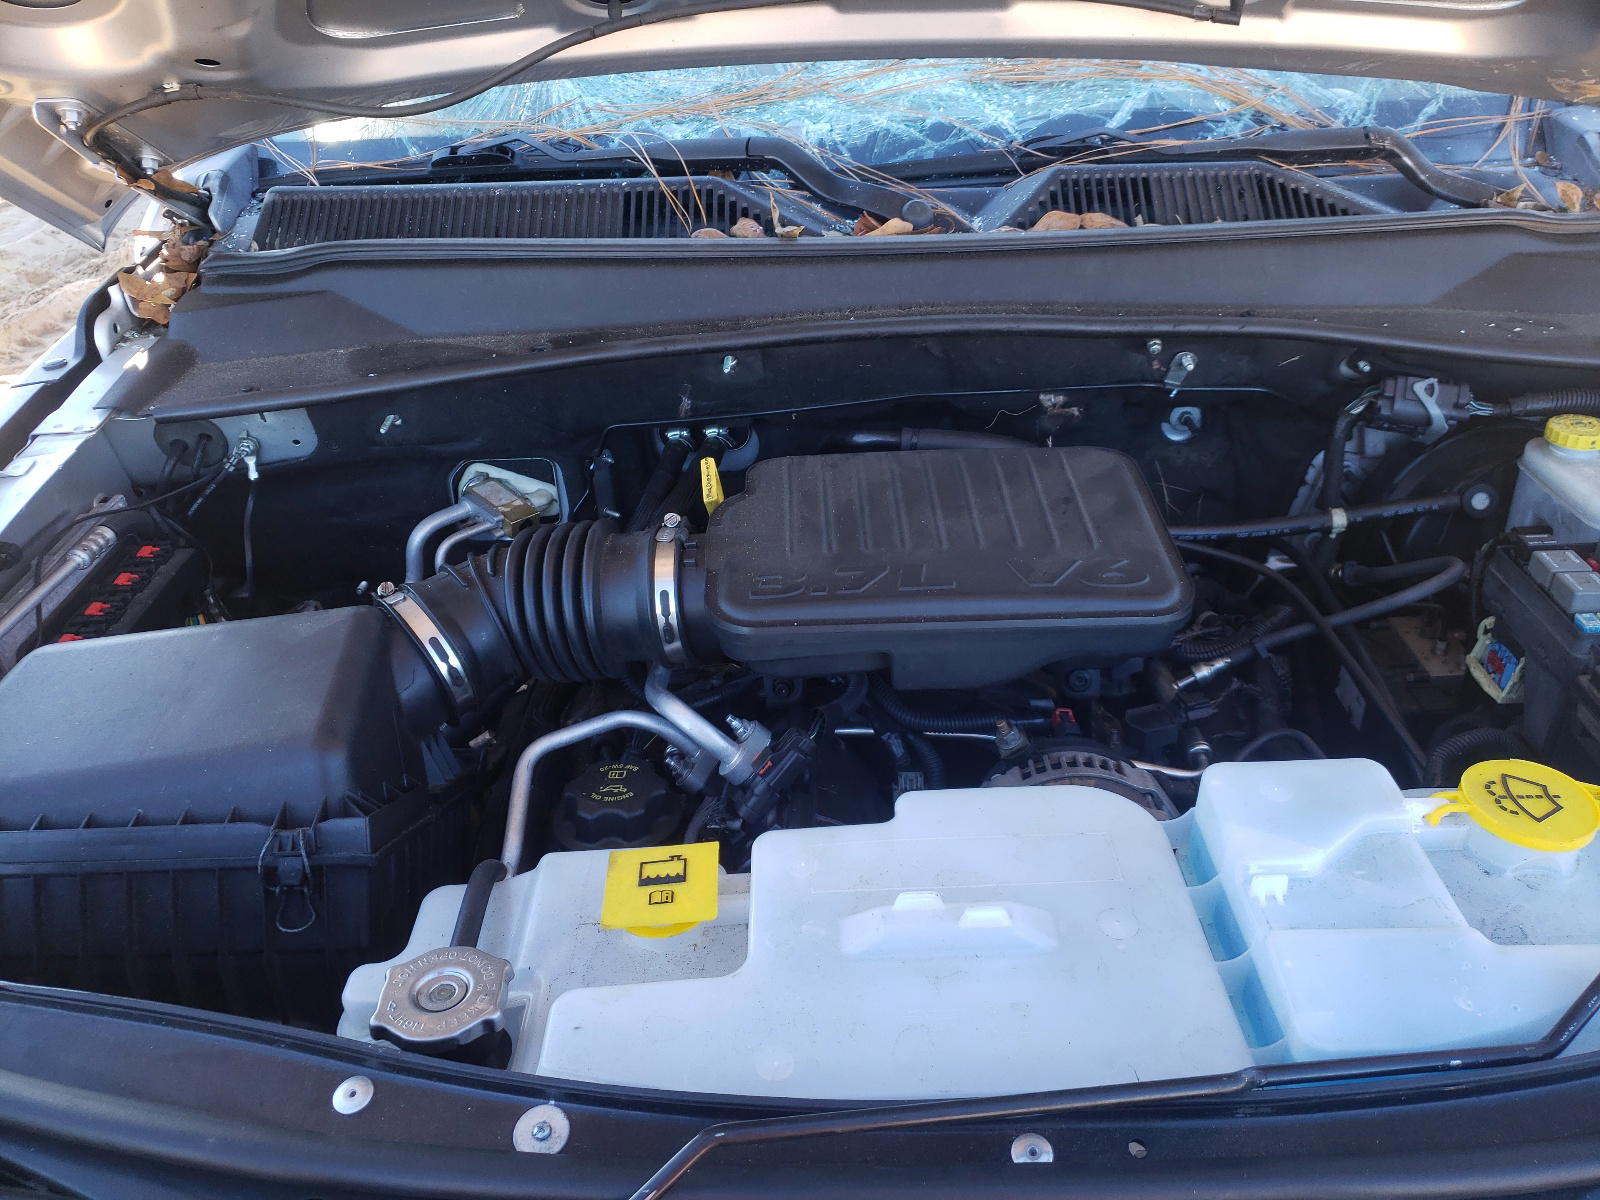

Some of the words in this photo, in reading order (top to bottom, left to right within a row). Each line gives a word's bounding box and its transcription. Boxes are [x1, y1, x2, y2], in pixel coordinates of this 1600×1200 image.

[749, 562, 957, 600] 3.7L
[1005, 558, 1151, 588] V6
[591, 792, 602, 800] OIL
[603, 791, 634, 801] ENGINE
[459, 951, 482, 969] NOT
[388, 1014, 425, 1033] TIGHT
